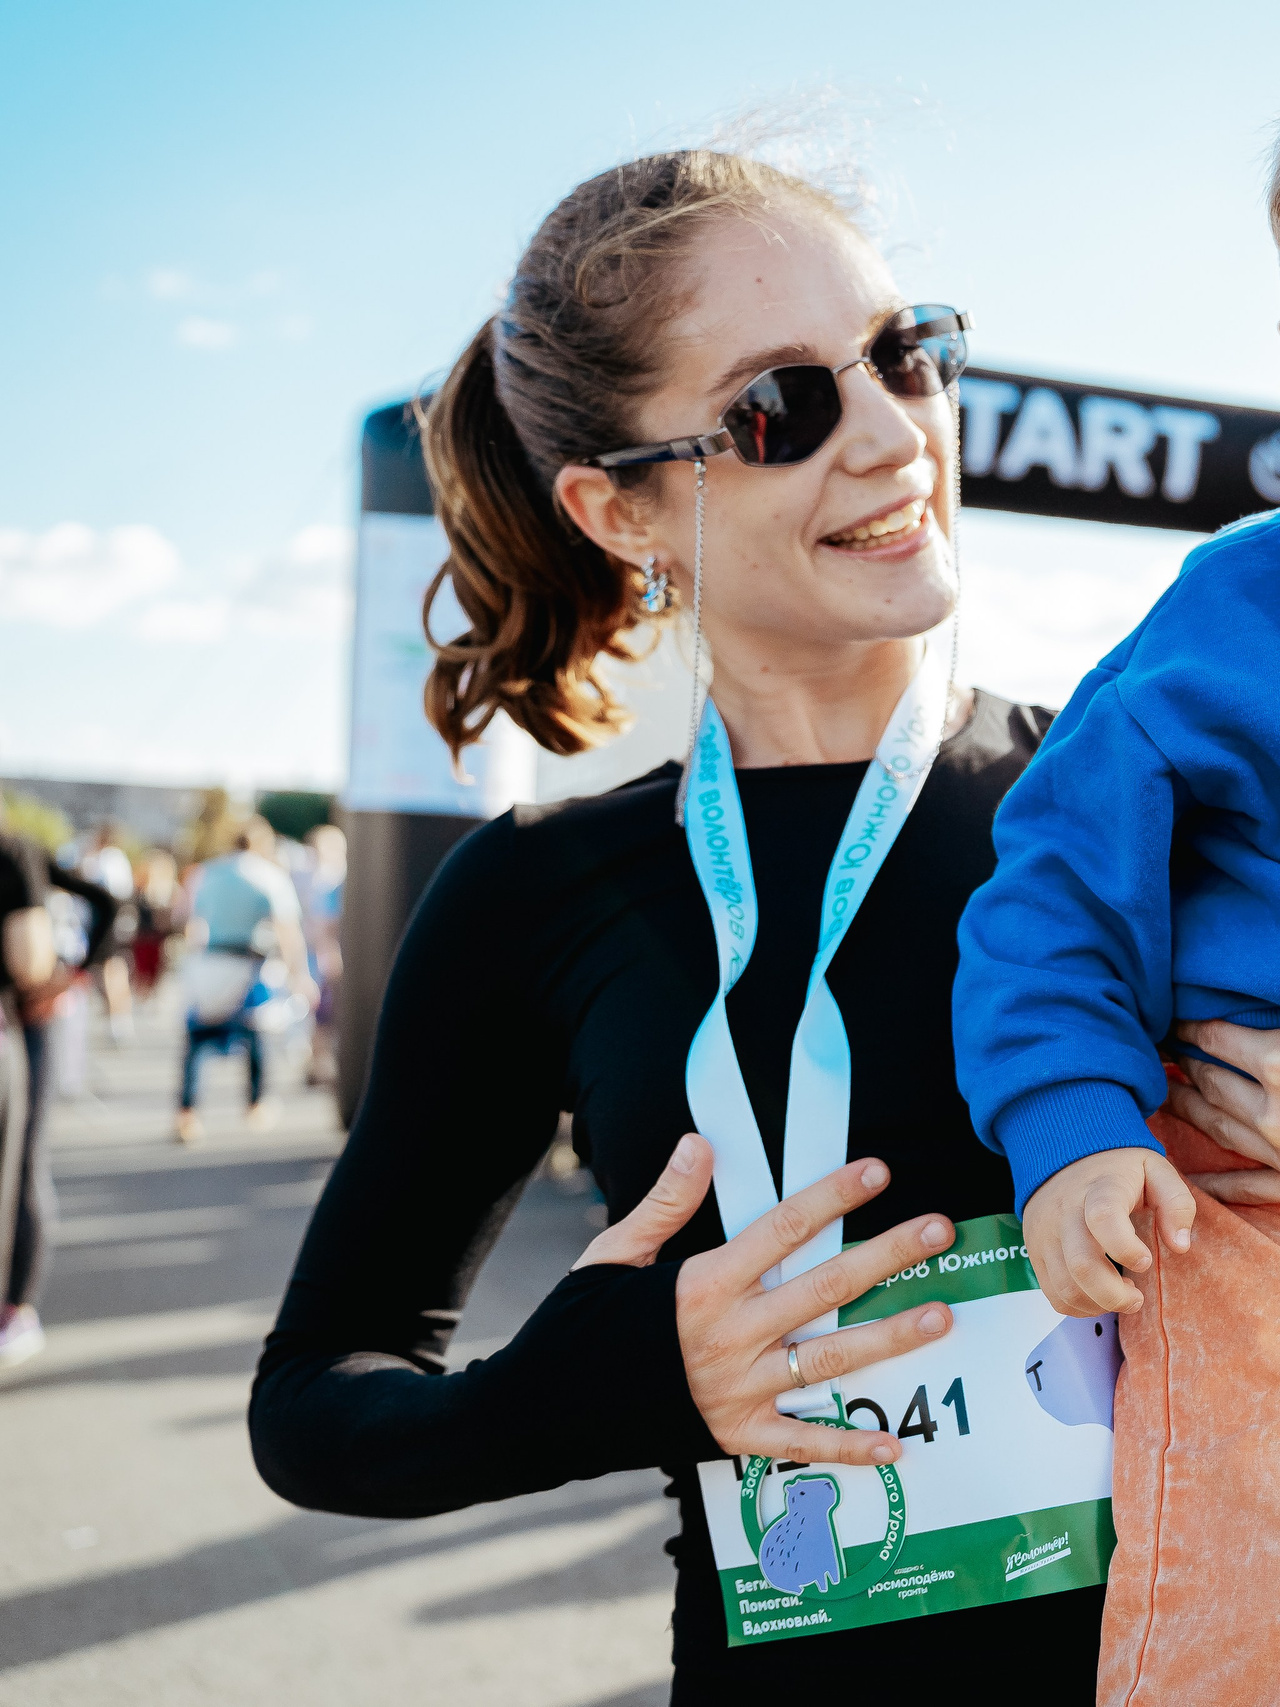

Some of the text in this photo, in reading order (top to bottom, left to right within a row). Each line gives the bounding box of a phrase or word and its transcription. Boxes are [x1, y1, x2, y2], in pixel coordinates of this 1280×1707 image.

[960, 376, 1222, 503] TART
[937, 1245, 1030, 1274] Южного
[846, 1376, 971, 1443] 041
[879, 1464, 904, 1561] ного Урала
[742, 1608, 832, 1636] Вдохновляй.
